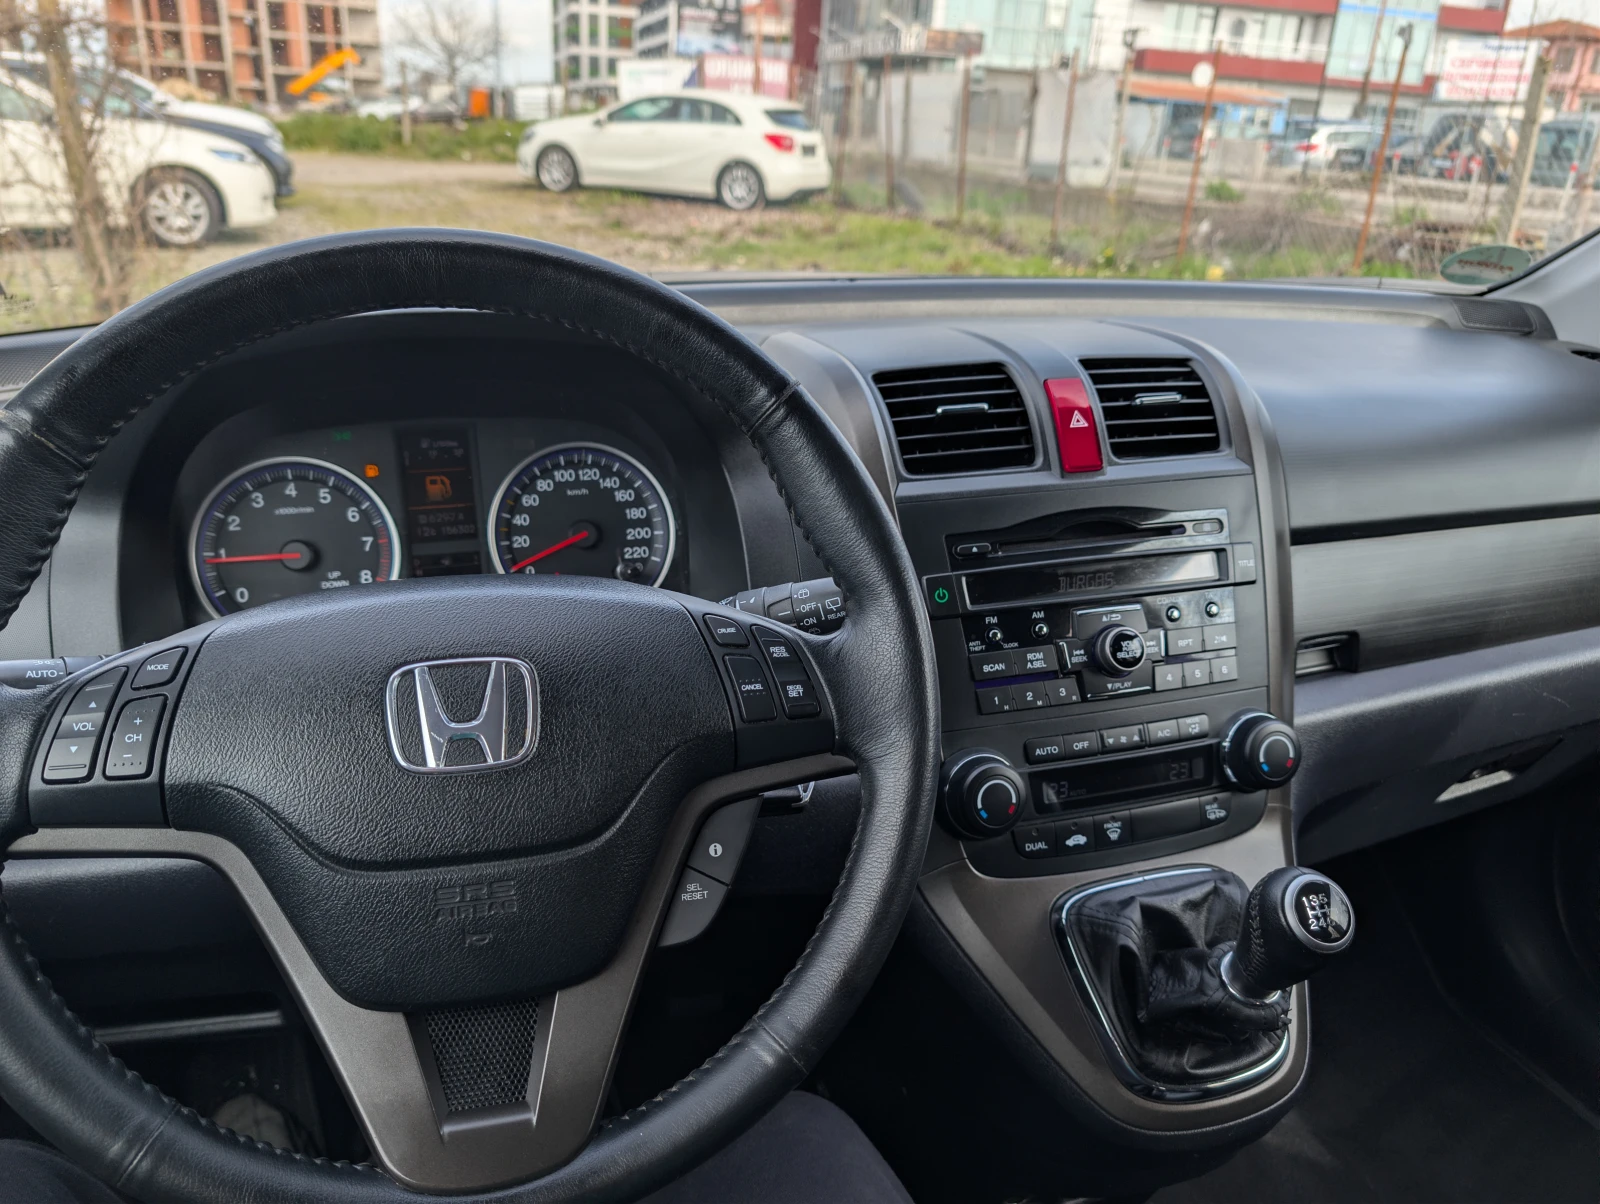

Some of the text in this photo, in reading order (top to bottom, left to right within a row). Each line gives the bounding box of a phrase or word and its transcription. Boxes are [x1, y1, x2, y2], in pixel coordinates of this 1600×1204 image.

[554, 469, 575, 482] 100
[578, 468, 600, 481] 120
[536, 479, 554, 492] 80
[599, 476, 620, 489] 140
[284, 482, 298, 497] 4
[566, 488, 589, 496] km/h
[252, 492, 265, 508] 3
[319, 488, 331, 504] 5
[522, 494, 539, 507] 60
[614, 489, 635, 502] 160
[347, 507, 360, 523] 6
[625, 508, 647, 520] 180
[227, 515, 242, 532] 2
[512, 514, 530, 526] 40
[626, 528, 651, 540] 200
[361, 536, 374, 551] 7
[512, 535, 530, 548] 20
[218, 548, 226, 560] 1
[624, 546, 649, 559] 220
[1238, 560, 1255, 568] TITLE
[327, 570, 341, 580] UP
[360, 569, 373, 584] 8
[321, 580, 350, 589] DOWN
[1059, 572, 1115, 592] BURGAS
[235, 587, 249, 603] 0
[800, 602, 818, 613] OFF
[827, 611, 846, 621] REAR
[1032, 610, 1045, 619] AM
[803, 616, 817, 626] ON
[985, 616, 998, 624] FM
[1178, 639, 1193, 647] RPT
[1027, 652, 1044, 660] RDM
[1071, 655, 1088, 663] SEEK
[147, 663, 170, 671] MODE
[983, 663, 1005, 673] SCAN
[1222, 666, 1228, 674] 6
[26, 670, 58, 678] AUTO
[1166, 673, 1173, 681] 4
[1195, 670, 1202, 678] 5
[1026, 692, 1033, 700] 2
[1059, 688, 1066, 696] 3
[994, 697, 999, 705] 1
[73, 722, 95, 731] VOL
[125, 733, 142, 742] CH
[1157, 729, 1171, 737] A/C
[1073, 741, 1089, 750] OFF
[1035, 746, 1059, 756] AUTO
[1169, 762, 1189, 780] 23
[1103, 821, 1122, 829] FRONT
[1025, 841, 1048, 851] DUAL
[686, 883, 703, 892] SEL
[681, 891, 709, 901] RESET
[1309, 895, 1319, 905] 3
[1319, 893, 1328, 904] 5
[1309, 919, 1319, 930] 2
